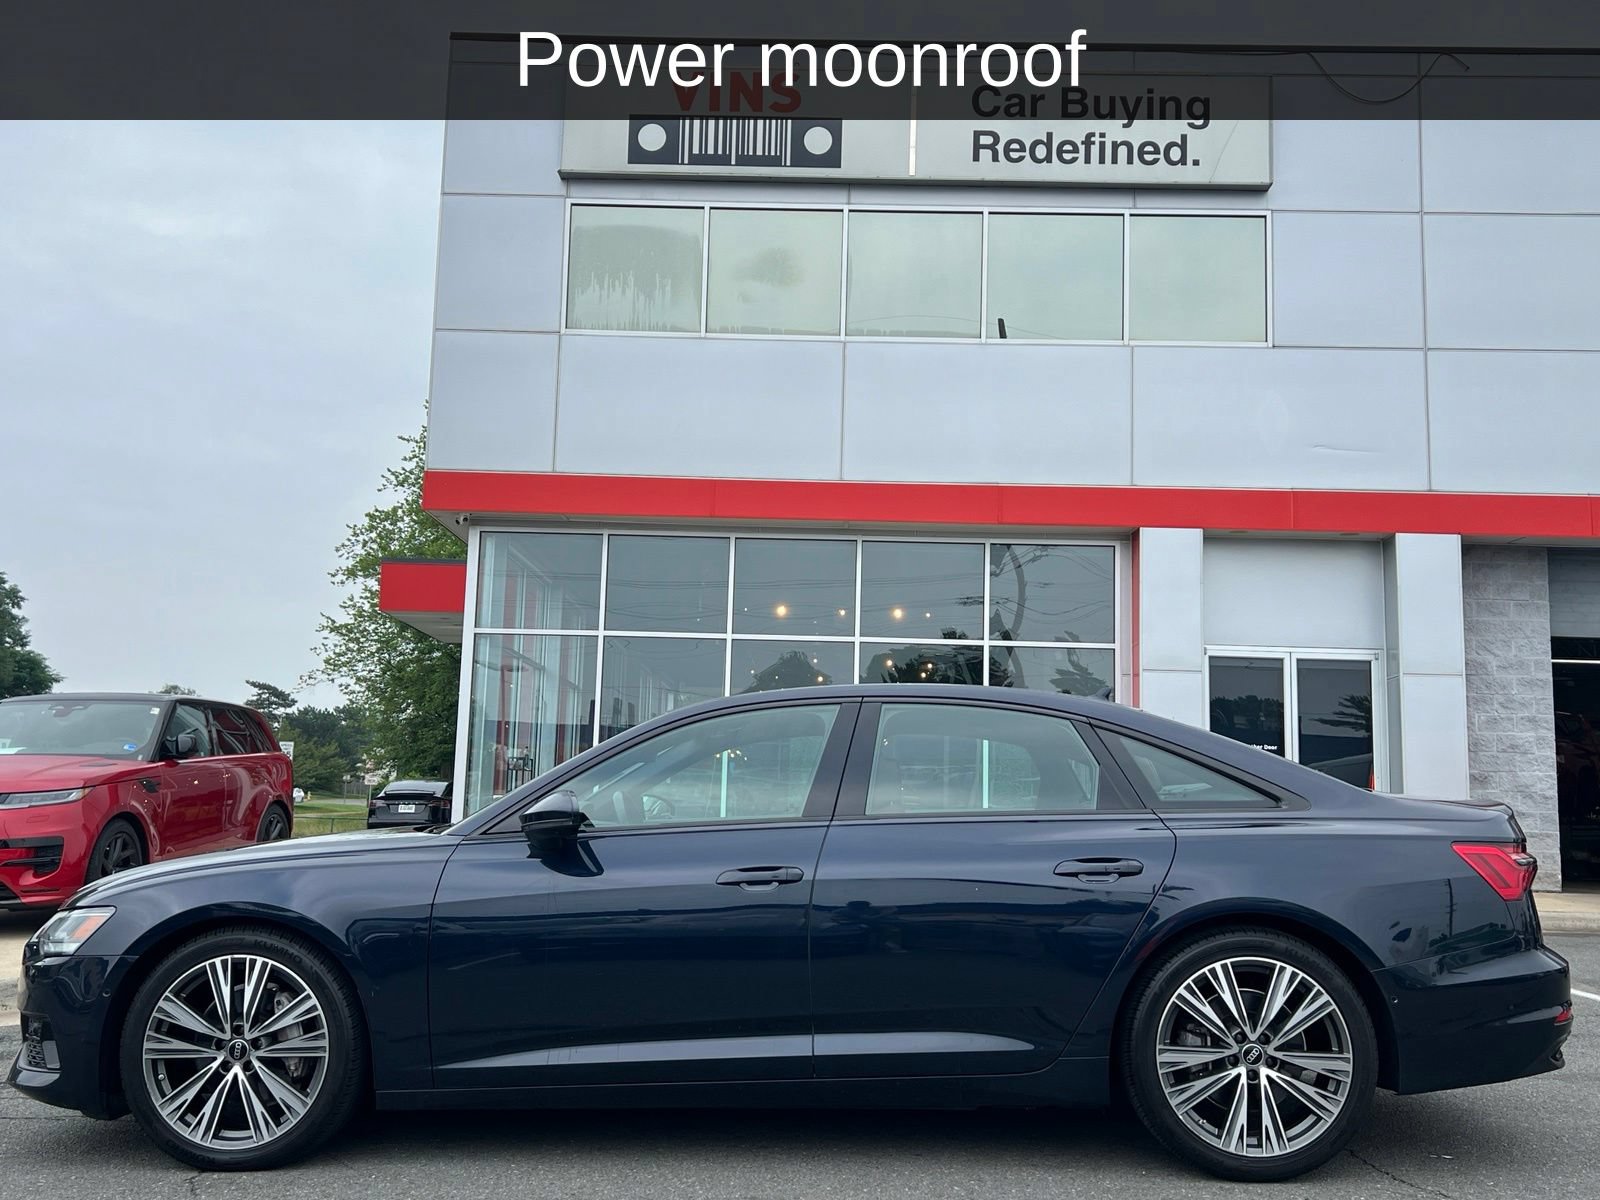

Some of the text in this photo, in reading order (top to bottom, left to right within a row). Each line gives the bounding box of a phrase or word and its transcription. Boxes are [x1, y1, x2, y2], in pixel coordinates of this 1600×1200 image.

[672, 71, 802, 114] VINS
[971, 84, 1212, 130] Car Buying
[971, 129, 1201, 167] Redefined.
